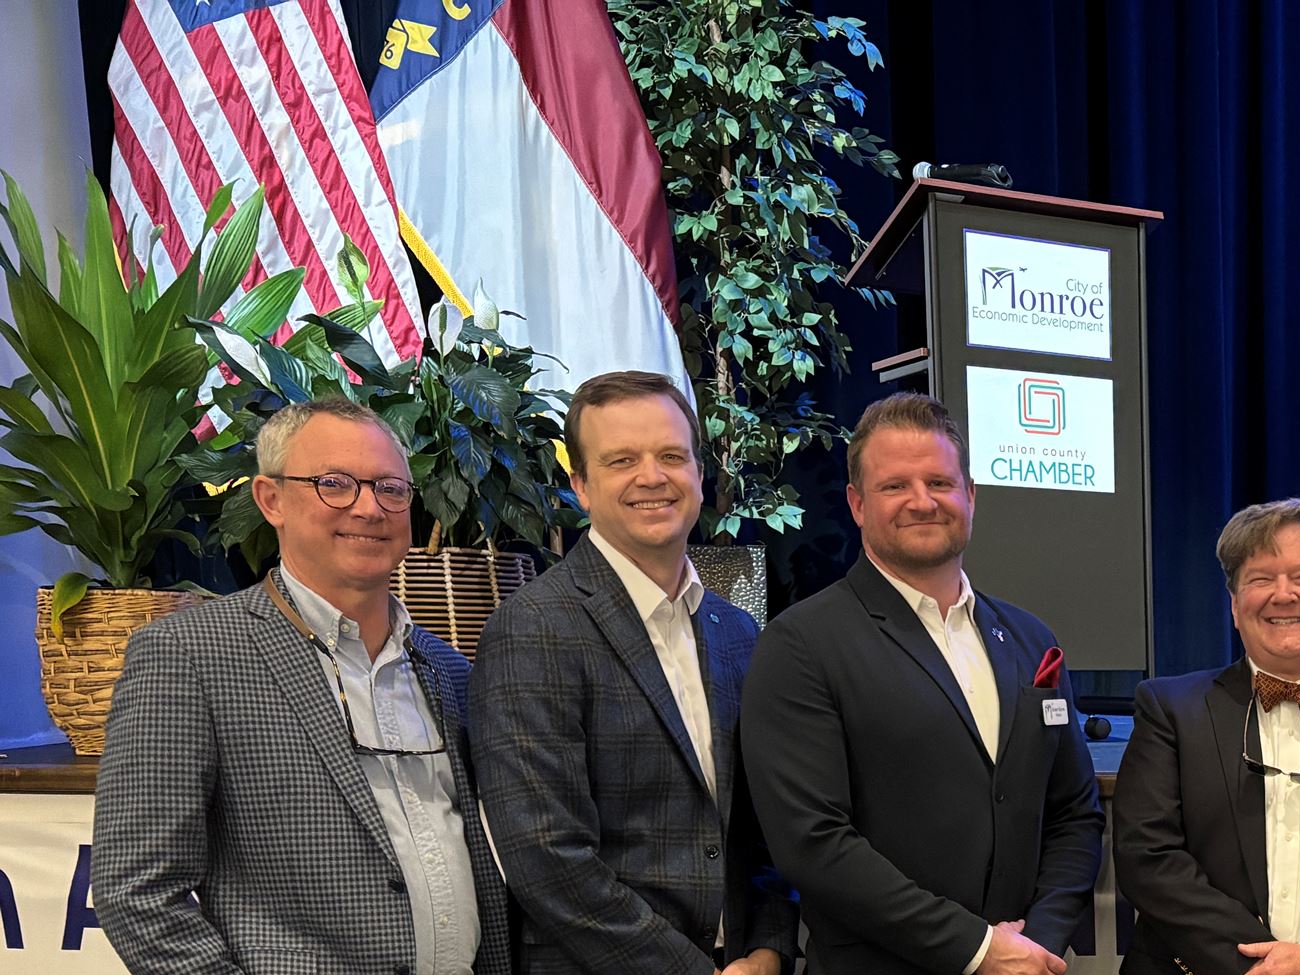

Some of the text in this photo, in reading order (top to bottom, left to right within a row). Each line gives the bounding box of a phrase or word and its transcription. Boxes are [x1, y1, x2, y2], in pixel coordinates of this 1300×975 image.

[980, 267, 1104, 320] Monroe
[1066, 278, 1103, 295] City of
[972, 306, 1104, 333] Economic Development
[998, 444, 1087, 461] union county
[990, 457, 1095, 487] CHAMBER
